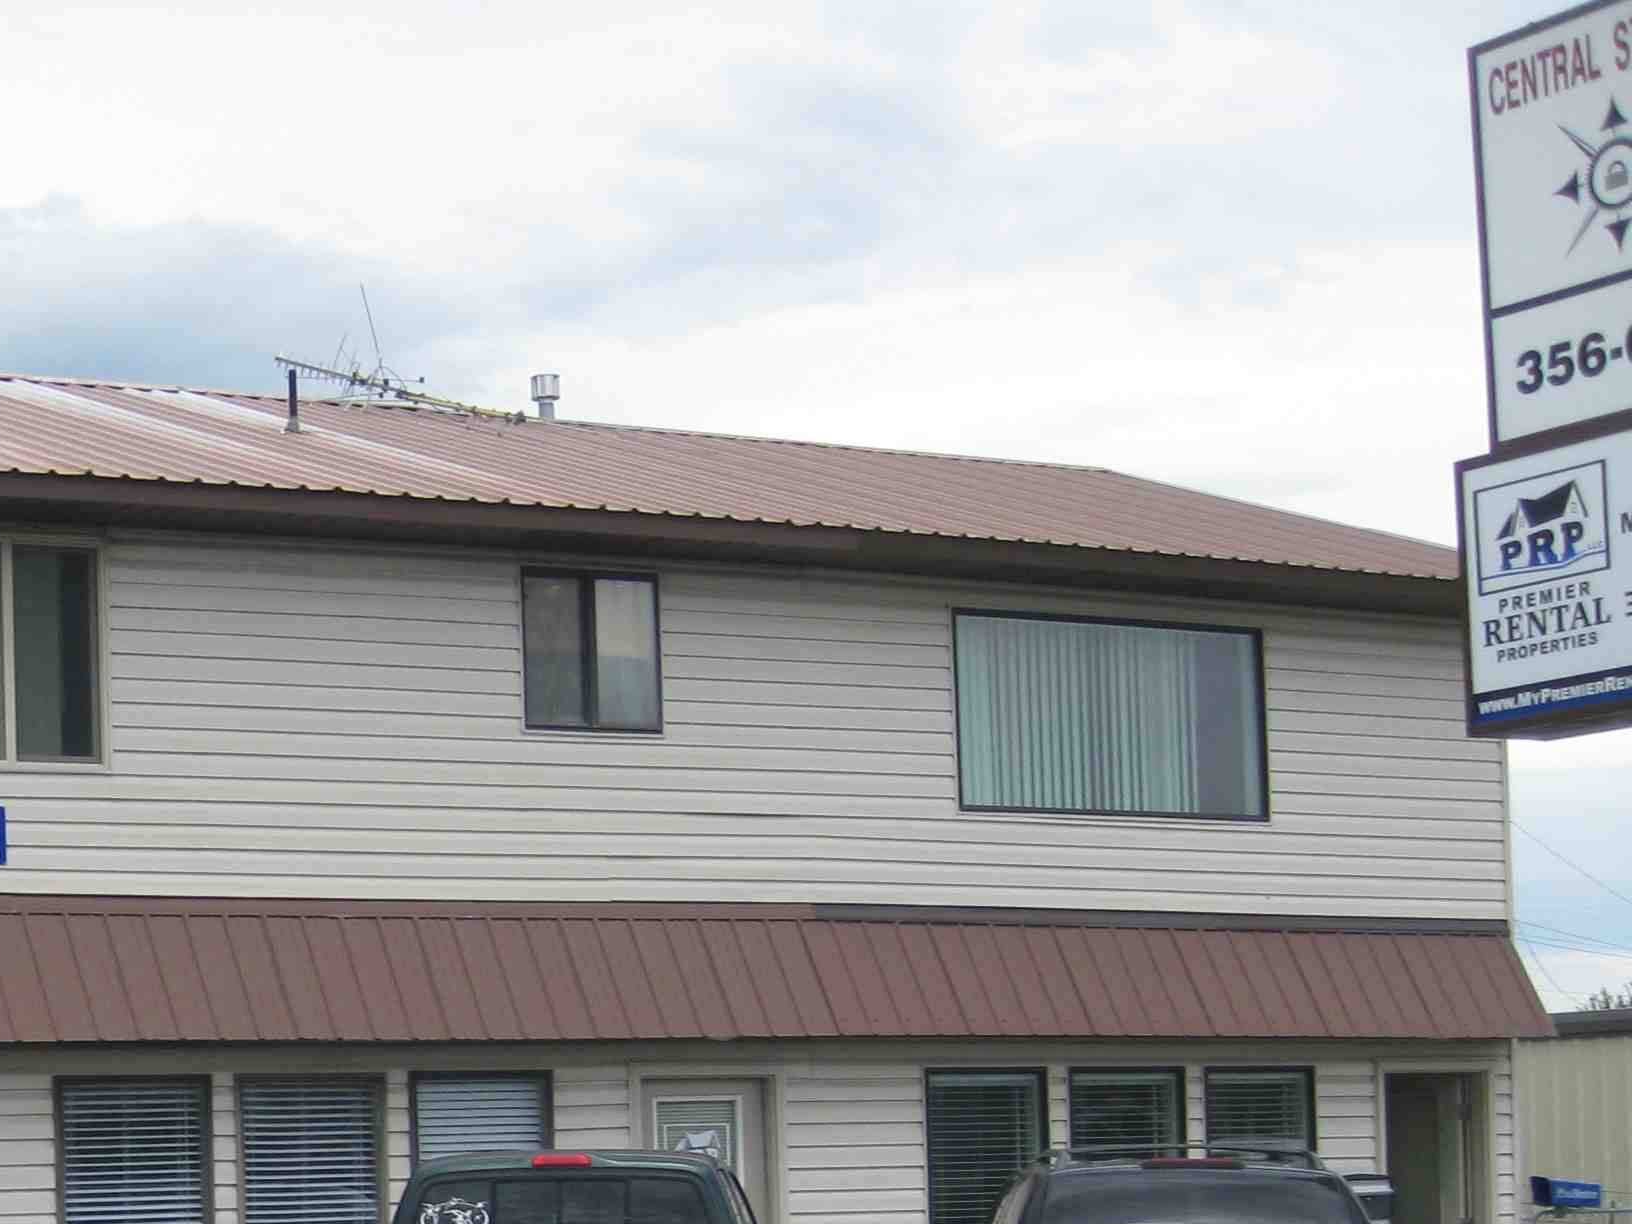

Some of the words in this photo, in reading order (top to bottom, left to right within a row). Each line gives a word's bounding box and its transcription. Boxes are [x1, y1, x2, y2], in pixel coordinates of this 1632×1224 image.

[1488, 34, 1602, 116] CENTRAL
[1614, 17, 1632, 72] S
[1516, 322, 1632, 395] 356-
[1499, 521, 1584, 572] PRP
[1482, 597, 1612, 648] RENTAL
[1498, 581, 1591, 614] PREMIER
[1497, 631, 1599, 663] PROPERTIES
